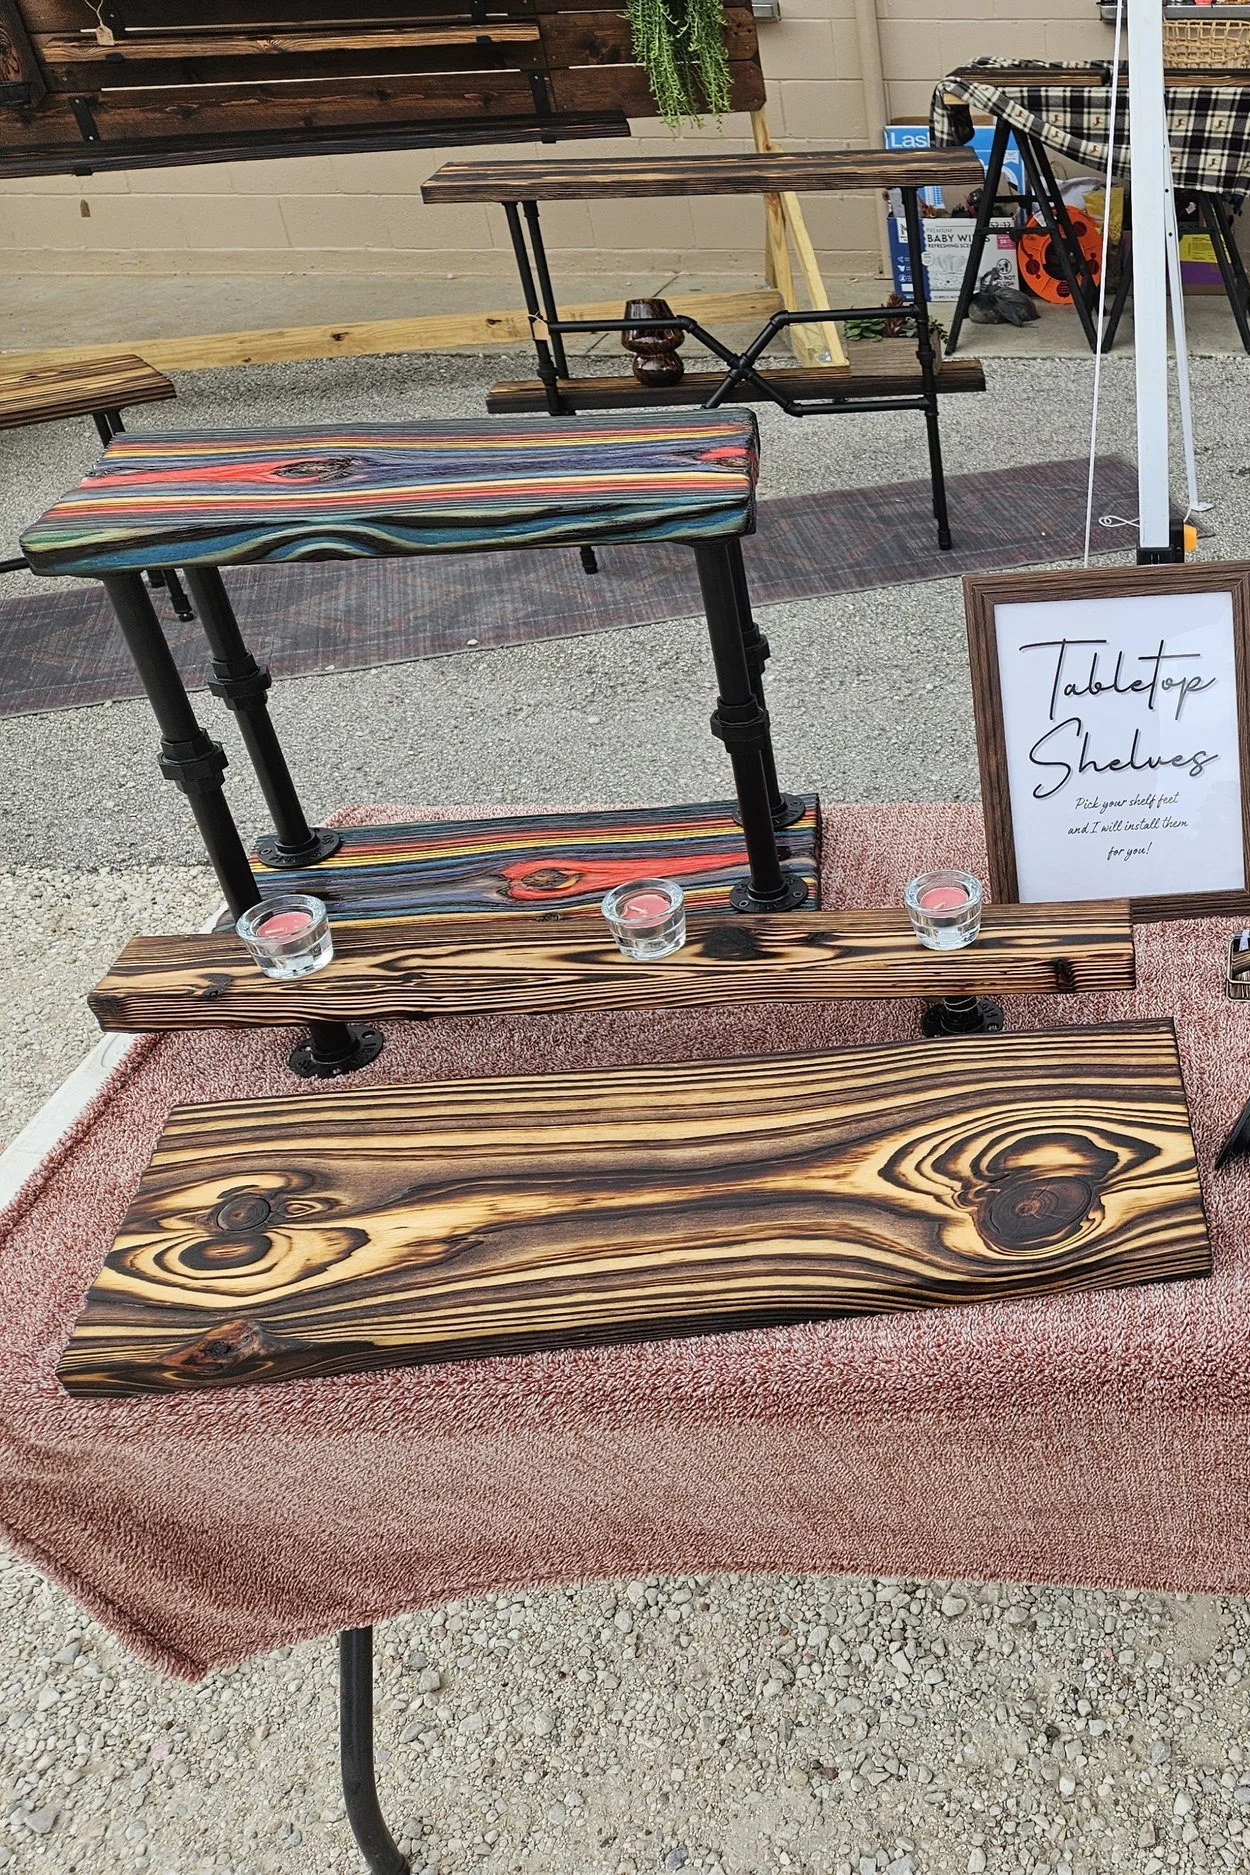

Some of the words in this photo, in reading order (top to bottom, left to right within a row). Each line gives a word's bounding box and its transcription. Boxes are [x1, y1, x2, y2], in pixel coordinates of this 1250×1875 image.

[927, 234, 954, 243] BABY
[957, 234, 991, 243] WIS
[1018, 638, 1217, 721] Tabletop
[1028, 717, 1219, 799] Shelves
[1074, 796, 1101, 810] Pick
[1099, 799, 1128, 814] your
[1129, 793, 1156, 809] shelf
[1156, 791, 1180, 808] feet
[1068, 822, 1089, 834] and
[1090, 821, 1101, 834] I
[1101, 820, 1123, 832] will
[1124, 817, 1160, 831] install
[1162, 815, 1189, 828] them
[1107, 846, 1125, 861] for
[1124, 841, 1153, 862] you!
